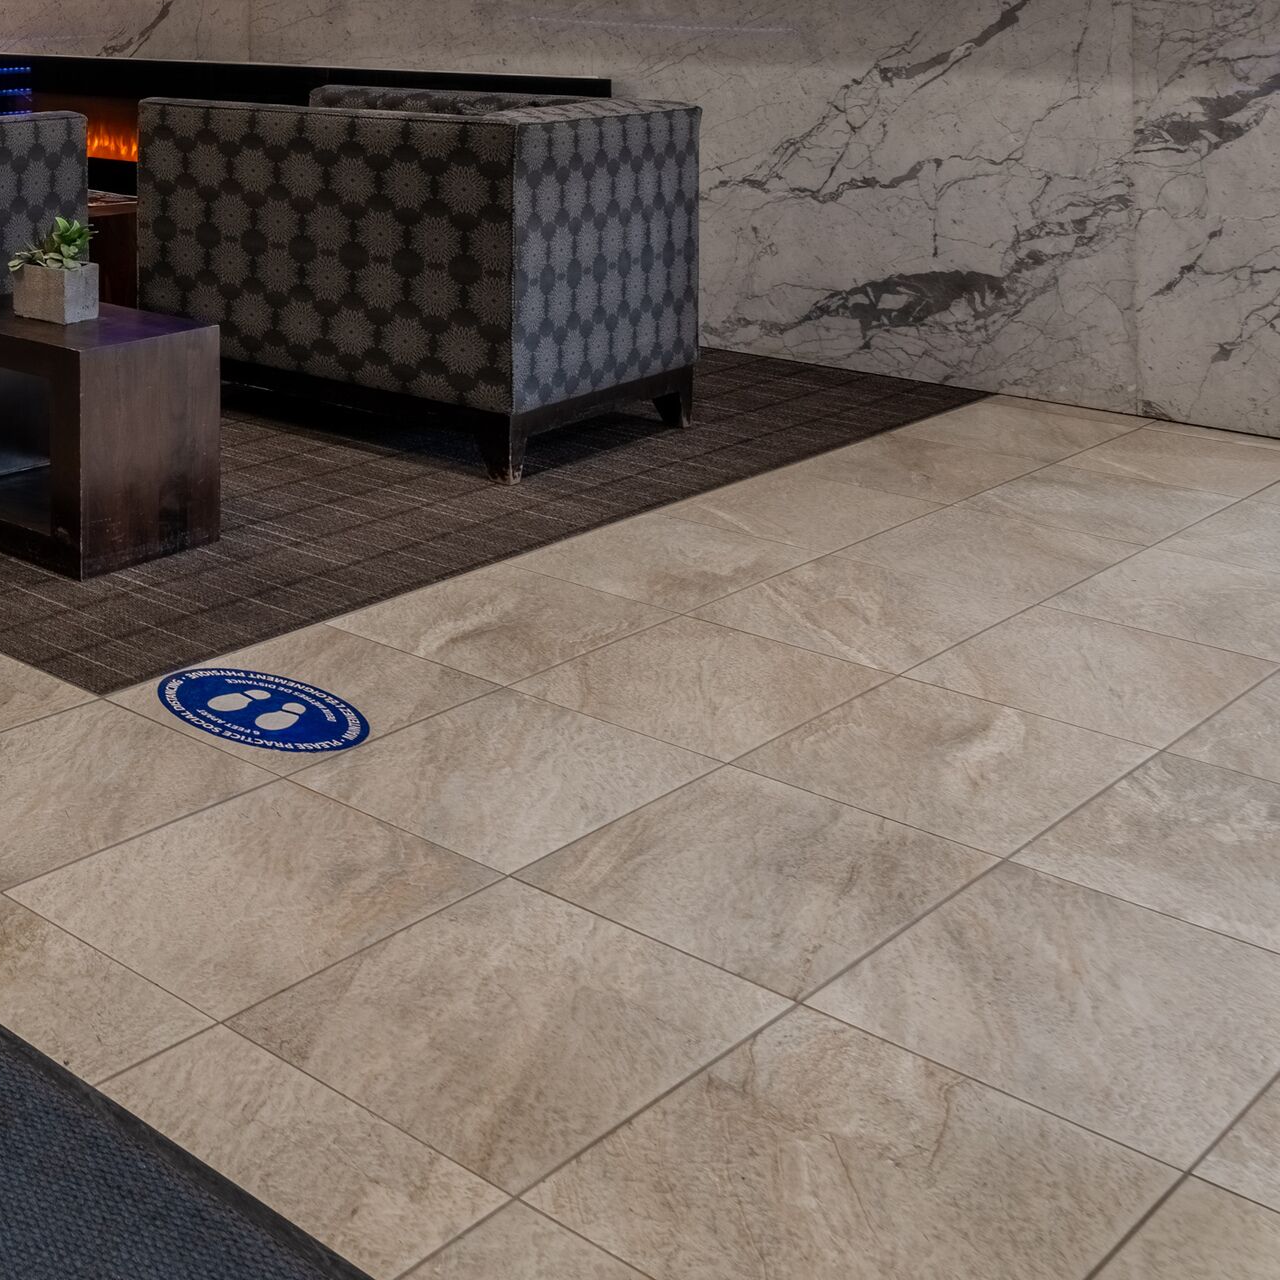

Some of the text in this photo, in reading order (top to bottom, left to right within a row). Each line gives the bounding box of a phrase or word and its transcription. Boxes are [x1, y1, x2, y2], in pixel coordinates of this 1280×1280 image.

[224, 678, 277, 689] DISTANCE
[277, 686, 293, 694] DE
[181, 711, 222, 733] SOCIAL
[196, 708, 226, 724] APART
[224, 722, 251, 734] FEET
[222, 730, 294, 749] PRACTICE
[295, 739, 343, 750] PLEASE
